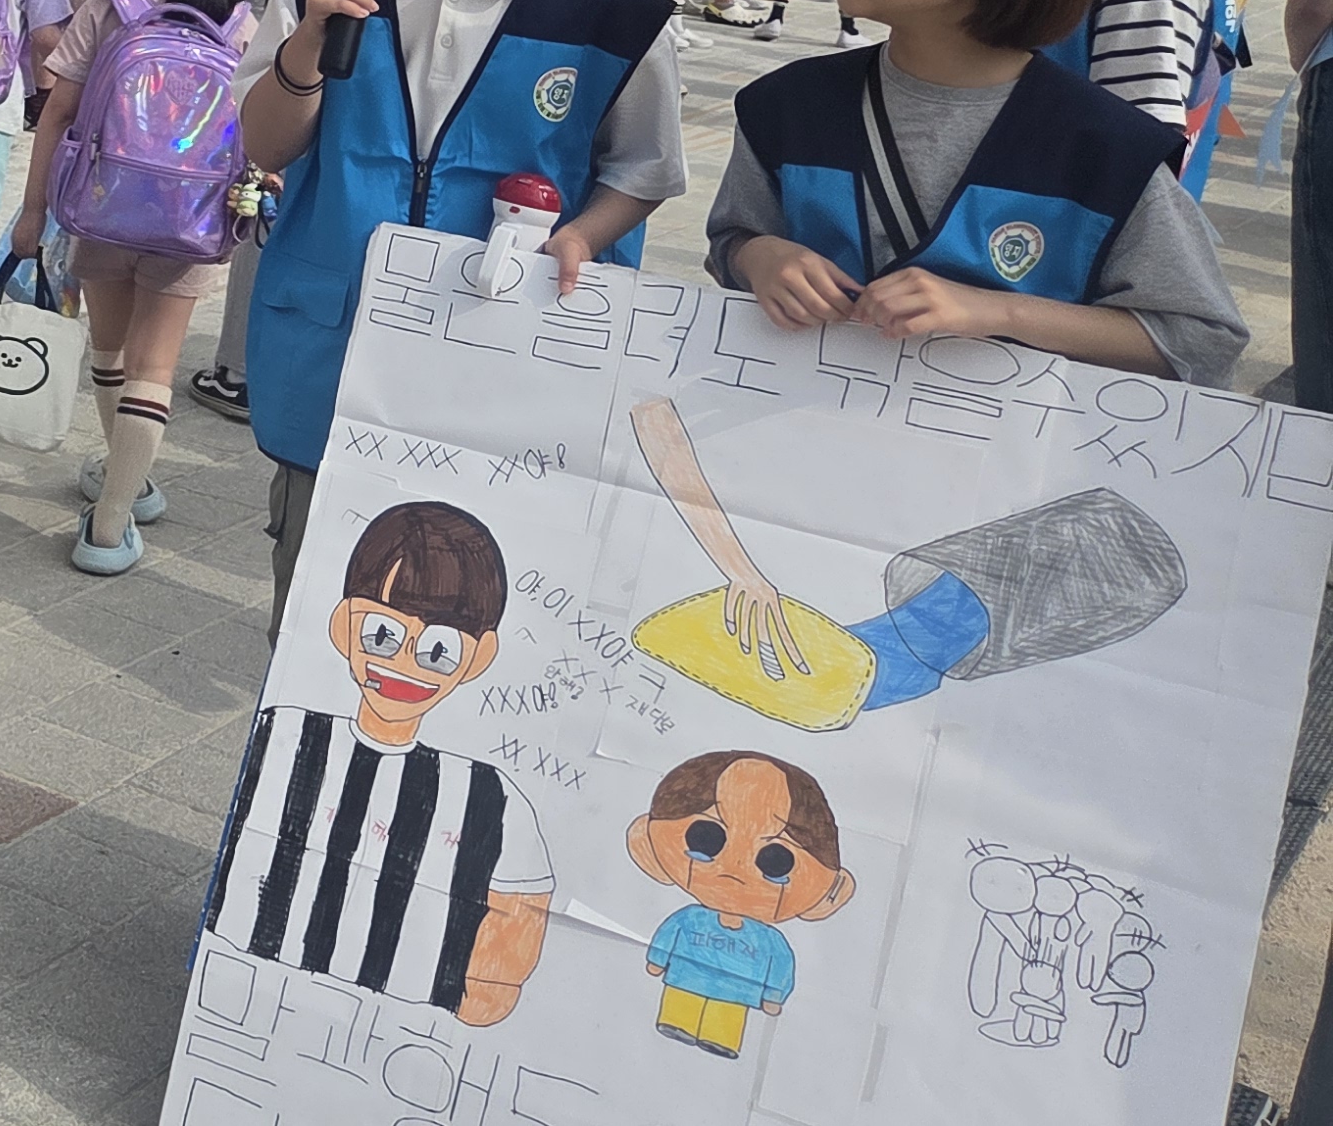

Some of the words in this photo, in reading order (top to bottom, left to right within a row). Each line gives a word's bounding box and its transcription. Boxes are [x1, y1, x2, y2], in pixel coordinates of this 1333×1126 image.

[368, 232, 524, 354] 물은
[532, 271, 781, 396] 흘려도
[186, 949, 384, 1087] 말과
